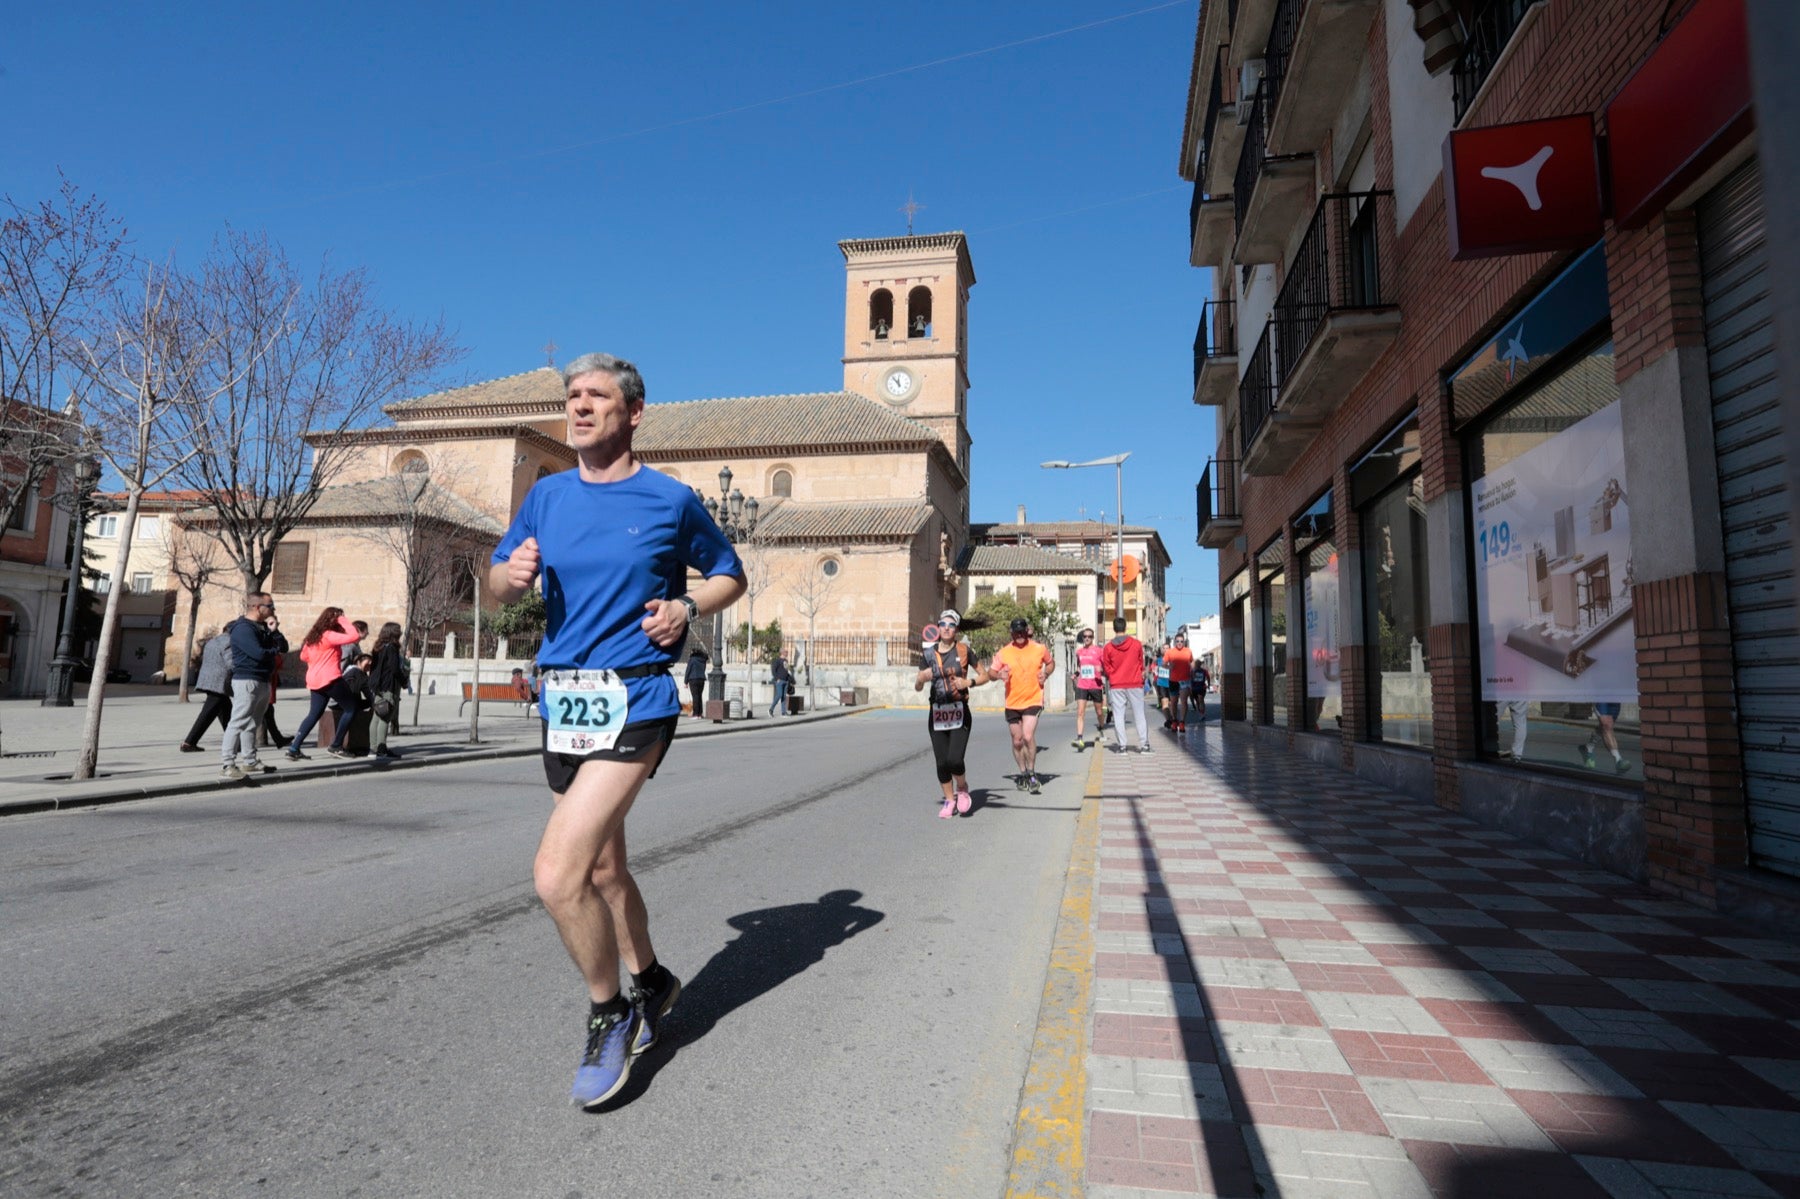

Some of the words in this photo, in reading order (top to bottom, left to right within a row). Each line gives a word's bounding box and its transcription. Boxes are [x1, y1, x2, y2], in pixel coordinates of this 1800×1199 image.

[1480, 521, 1510, 562] 149
[558, 697, 611, 726] 223
[935, 710, 962, 721] 2079
